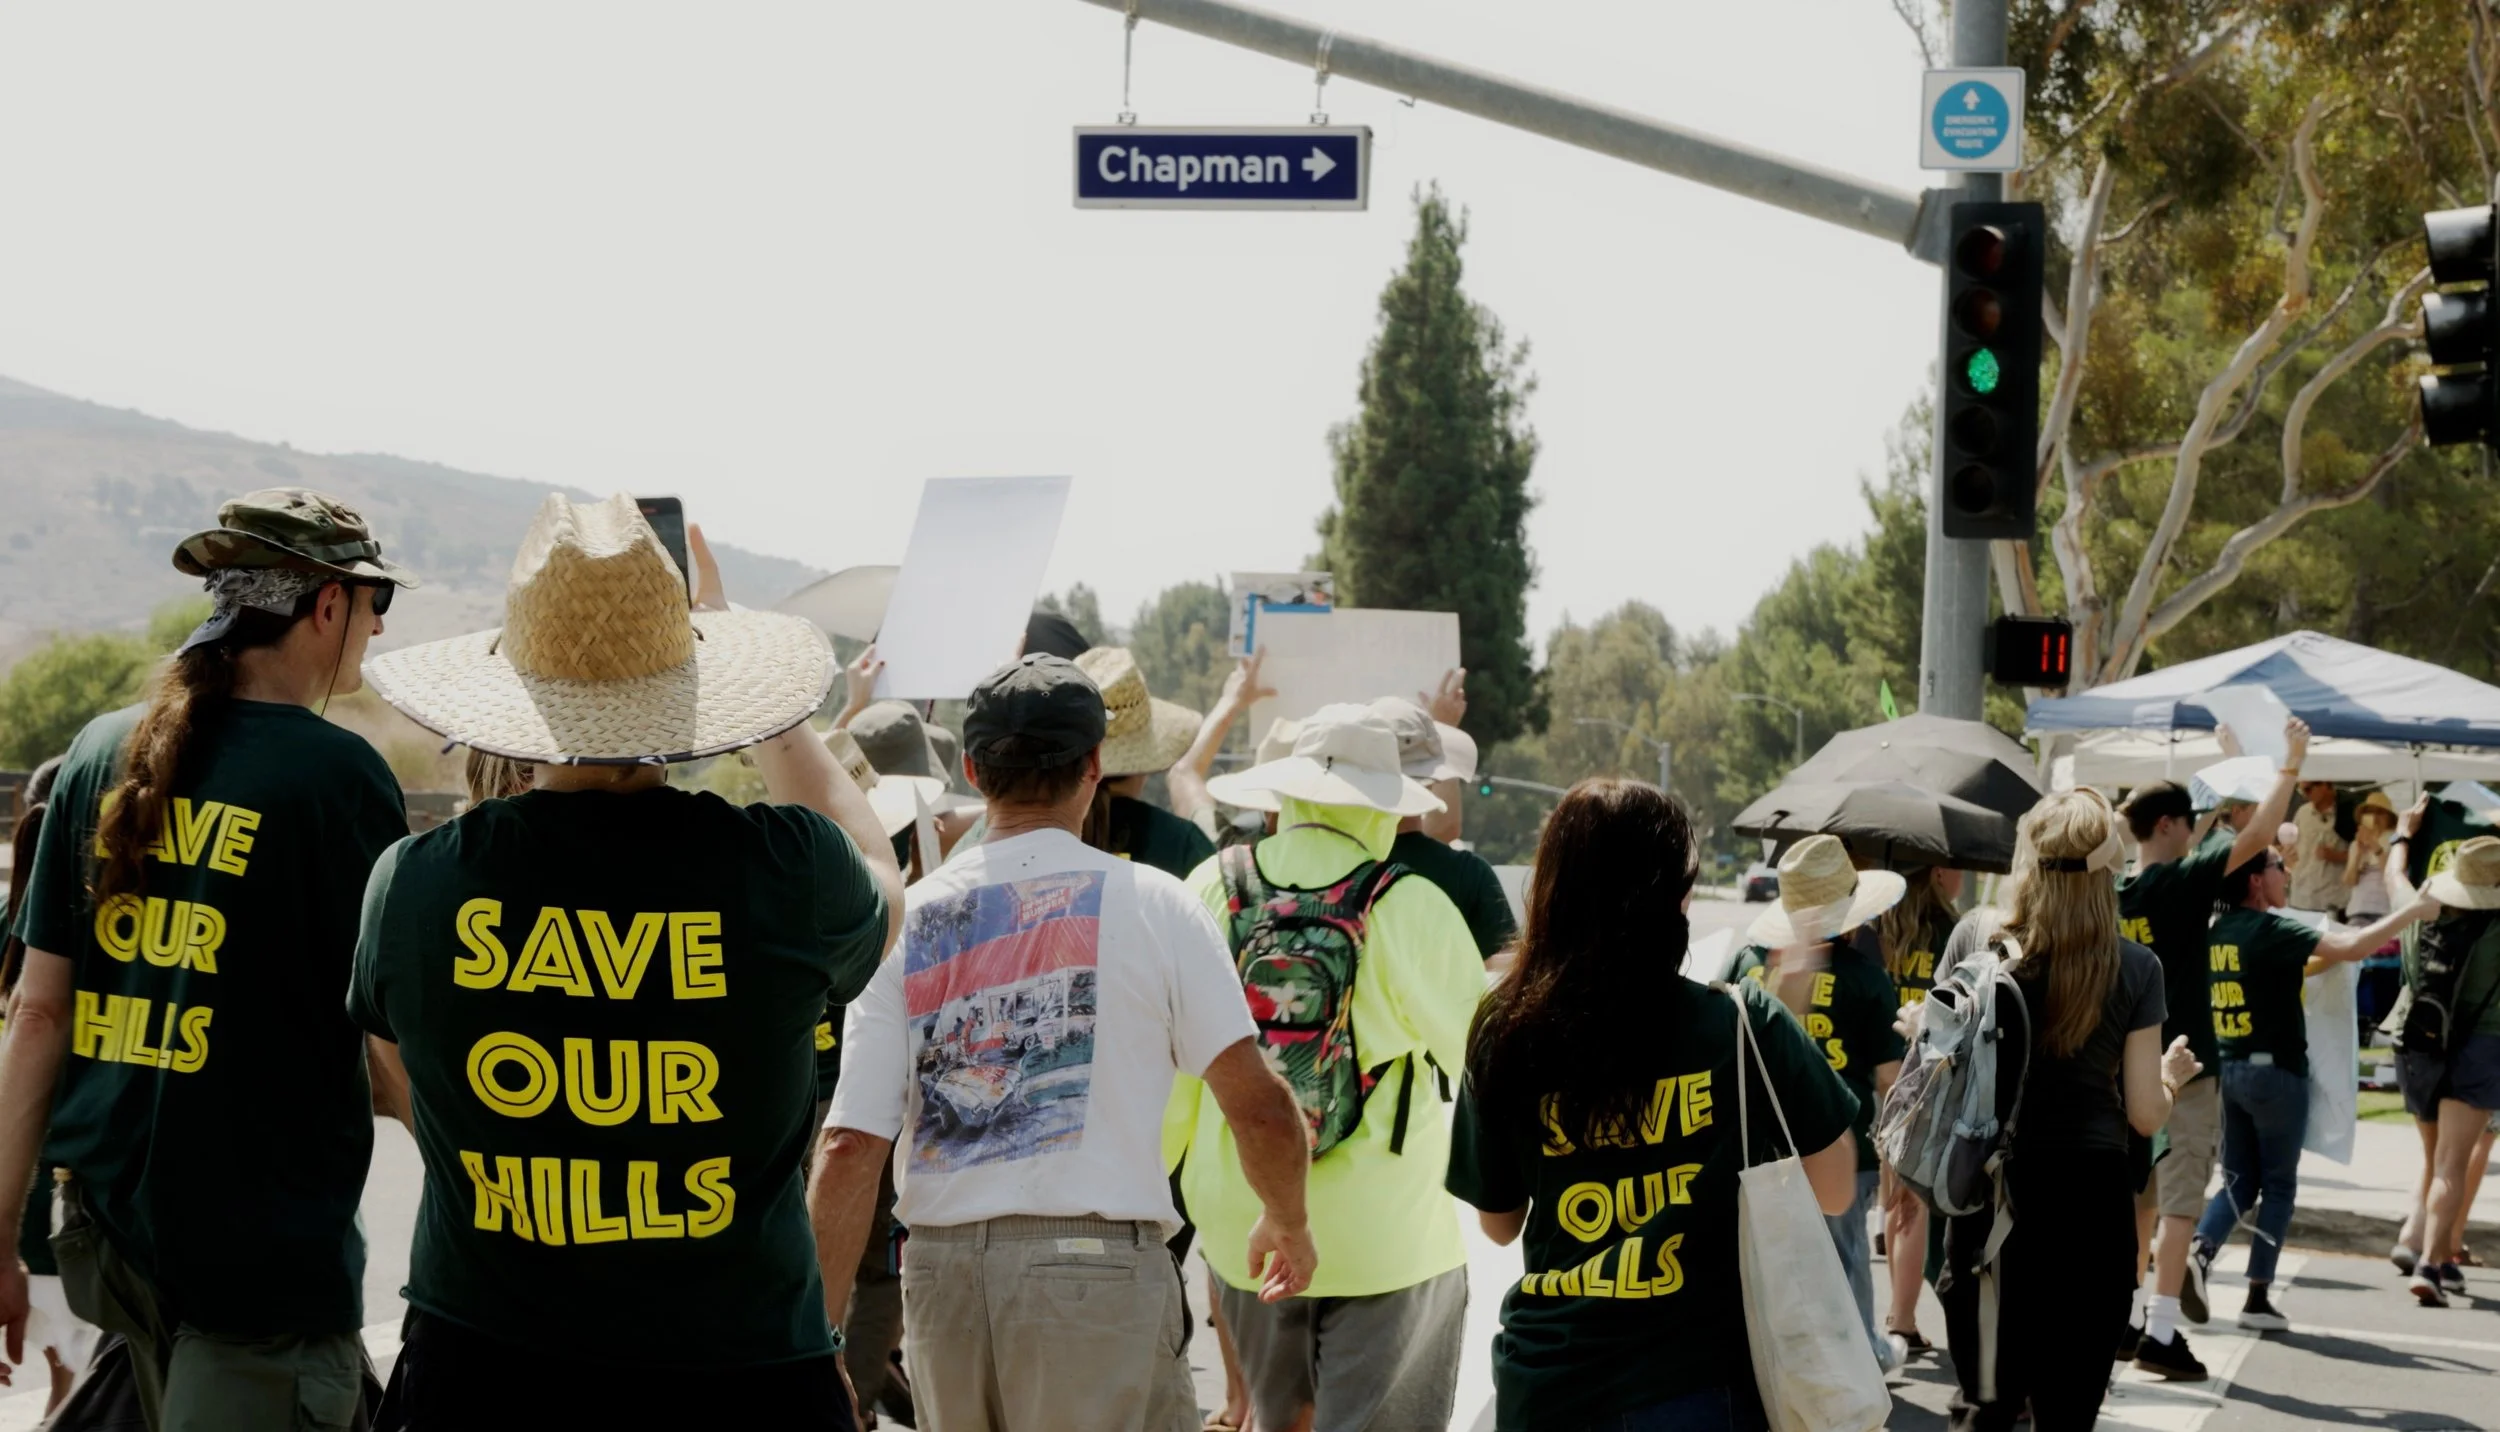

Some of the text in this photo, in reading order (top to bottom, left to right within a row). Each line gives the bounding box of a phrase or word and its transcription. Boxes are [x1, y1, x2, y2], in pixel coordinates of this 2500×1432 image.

[1098, 145, 1289, 191] Chapman
[2041, 633, 2067, 673] 11
[95, 893, 226, 974] OUR
[453, 897, 727, 1000] SAVE
[466, 1031, 724, 1126] OUR
[459, 1150, 736, 1246] HILLS
